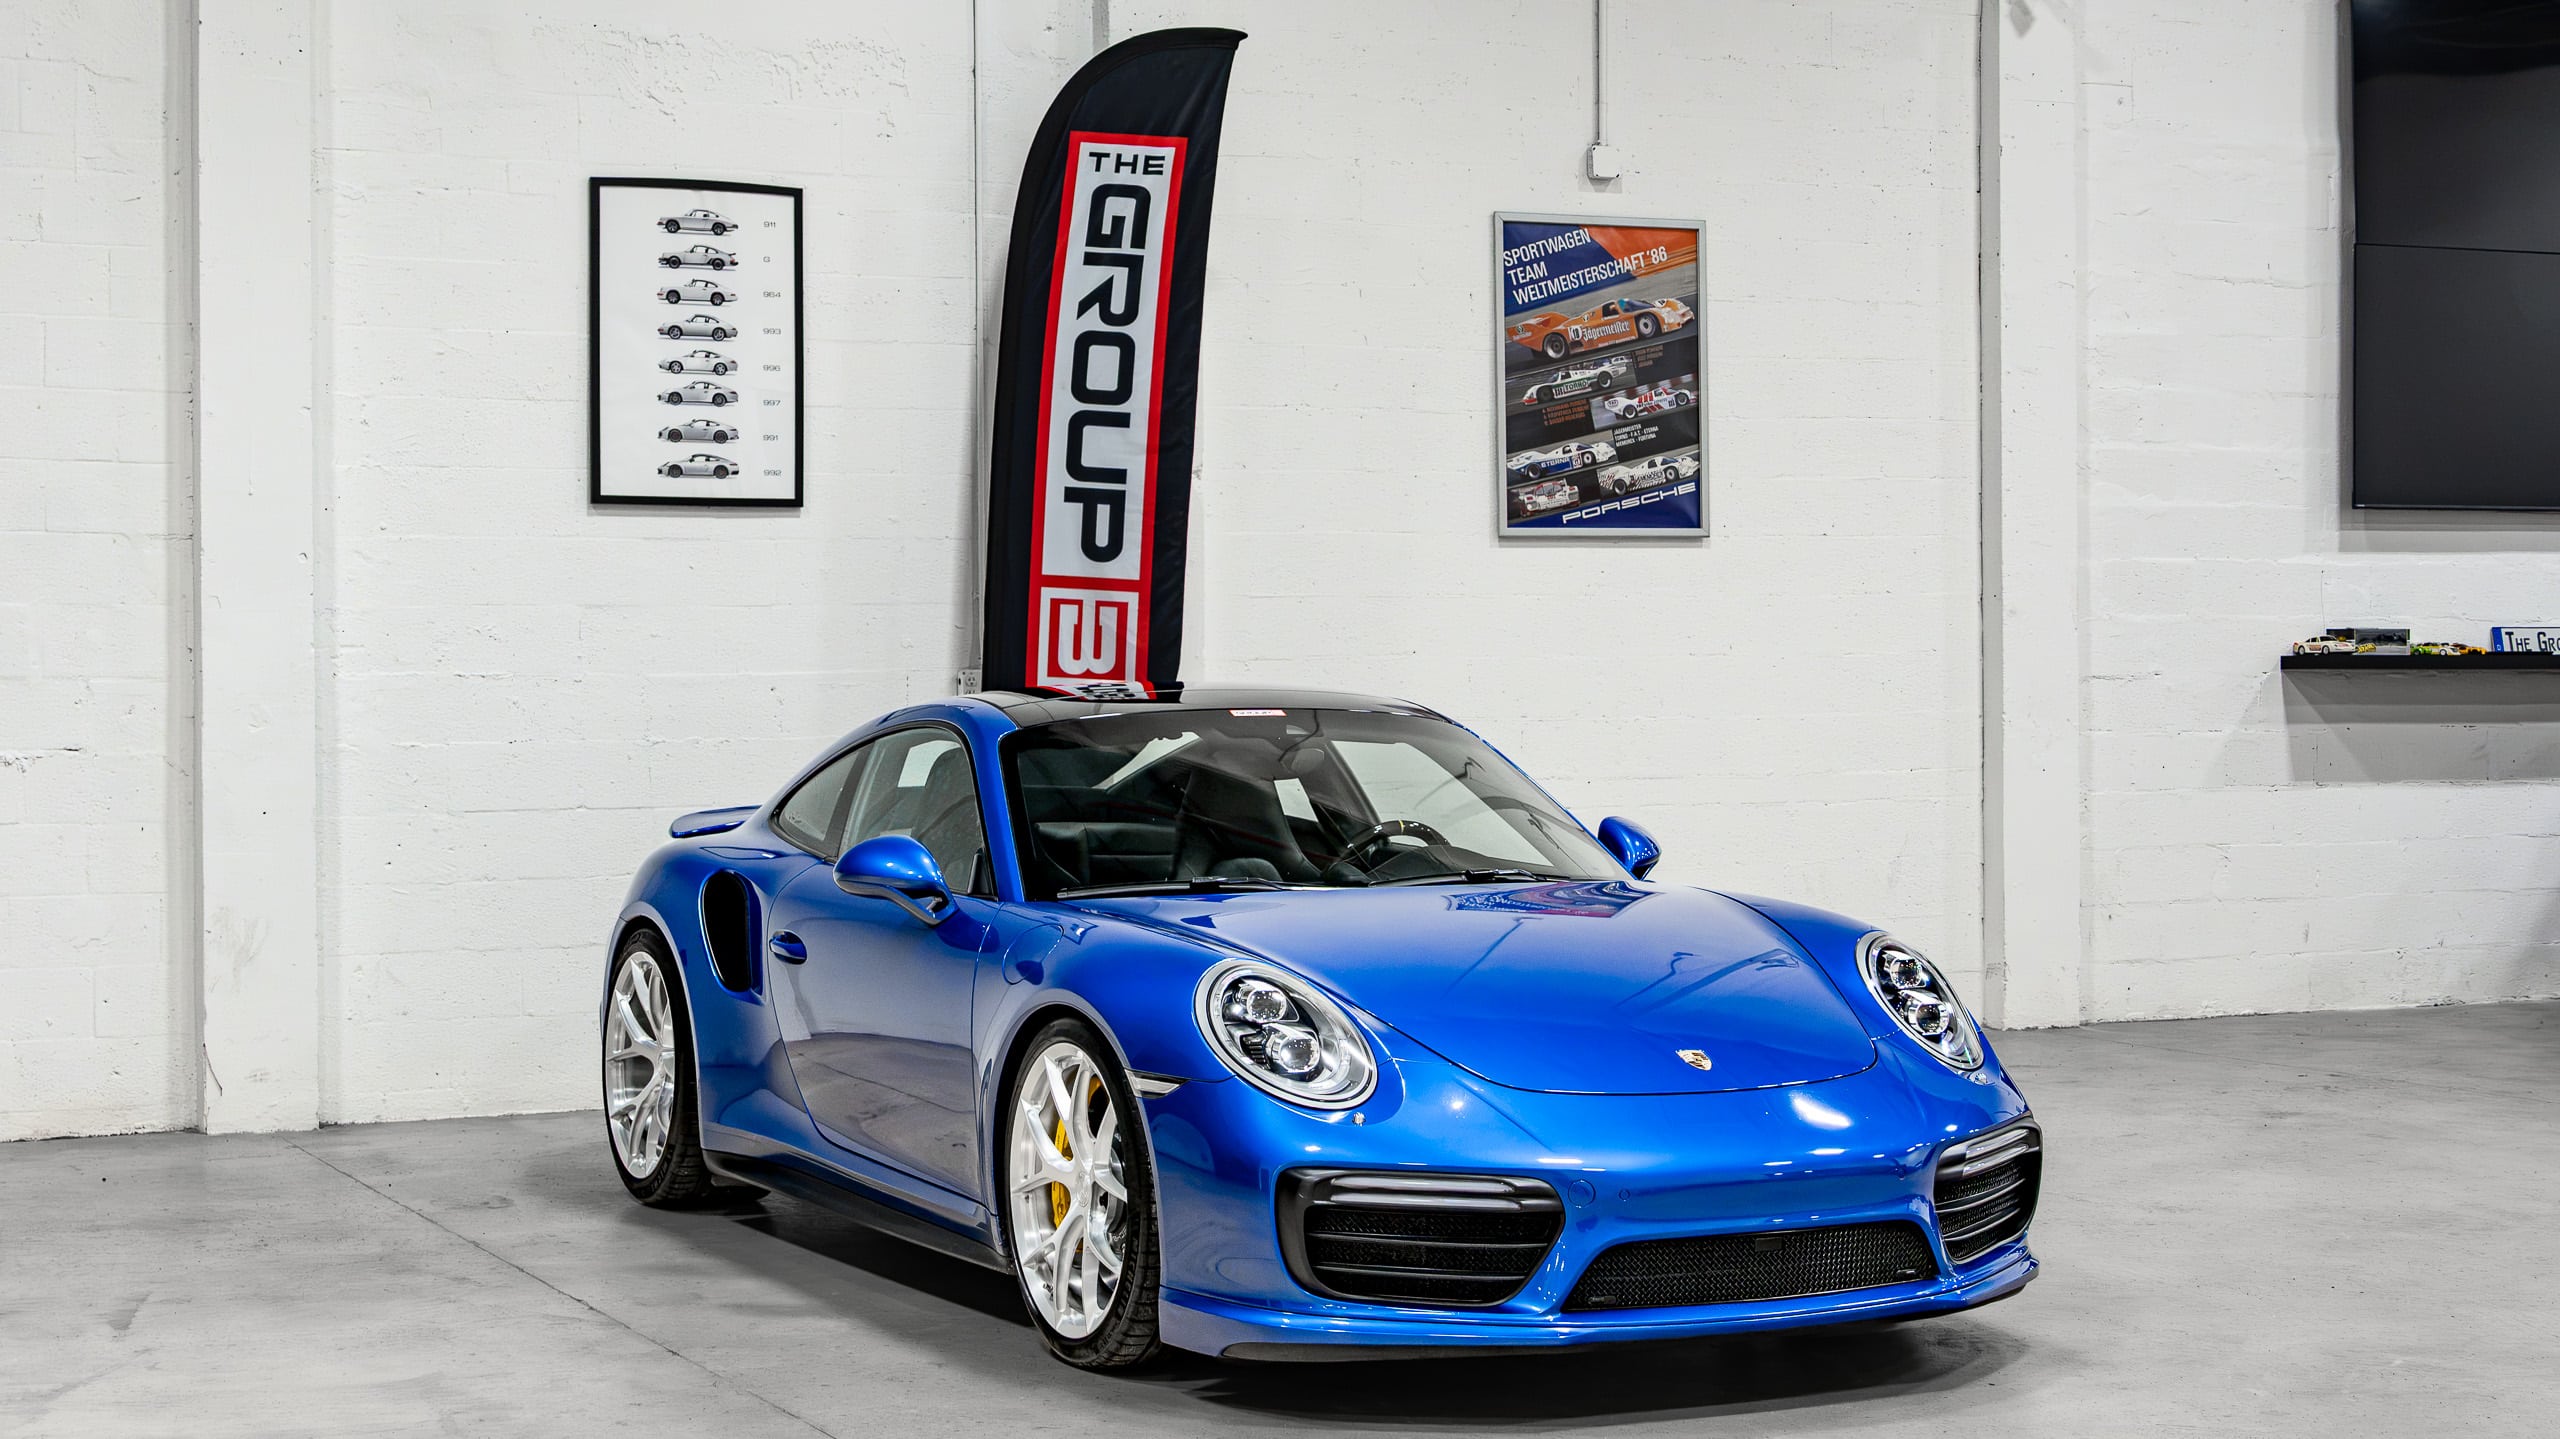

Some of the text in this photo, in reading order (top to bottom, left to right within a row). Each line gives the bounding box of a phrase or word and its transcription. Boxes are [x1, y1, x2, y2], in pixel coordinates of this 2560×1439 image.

[1089, 152, 1166, 176] THE
[1503, 228, 1592, 267] SPORTWAGEN
[1508, 262, 1548, 286] TEAM
[1513, 246, 1668, 305] WELTMEISTERSCHAFT '86
[1064, 183, 1151, 563] GROUP
[763, 399, 781, 407] 997
[763, 434, 778, 442] 991
[763, 469, 782, 477] 992
[1562, 482, 1697, 524] PORSCHE
[1057, 602, 1118, 676] 3
